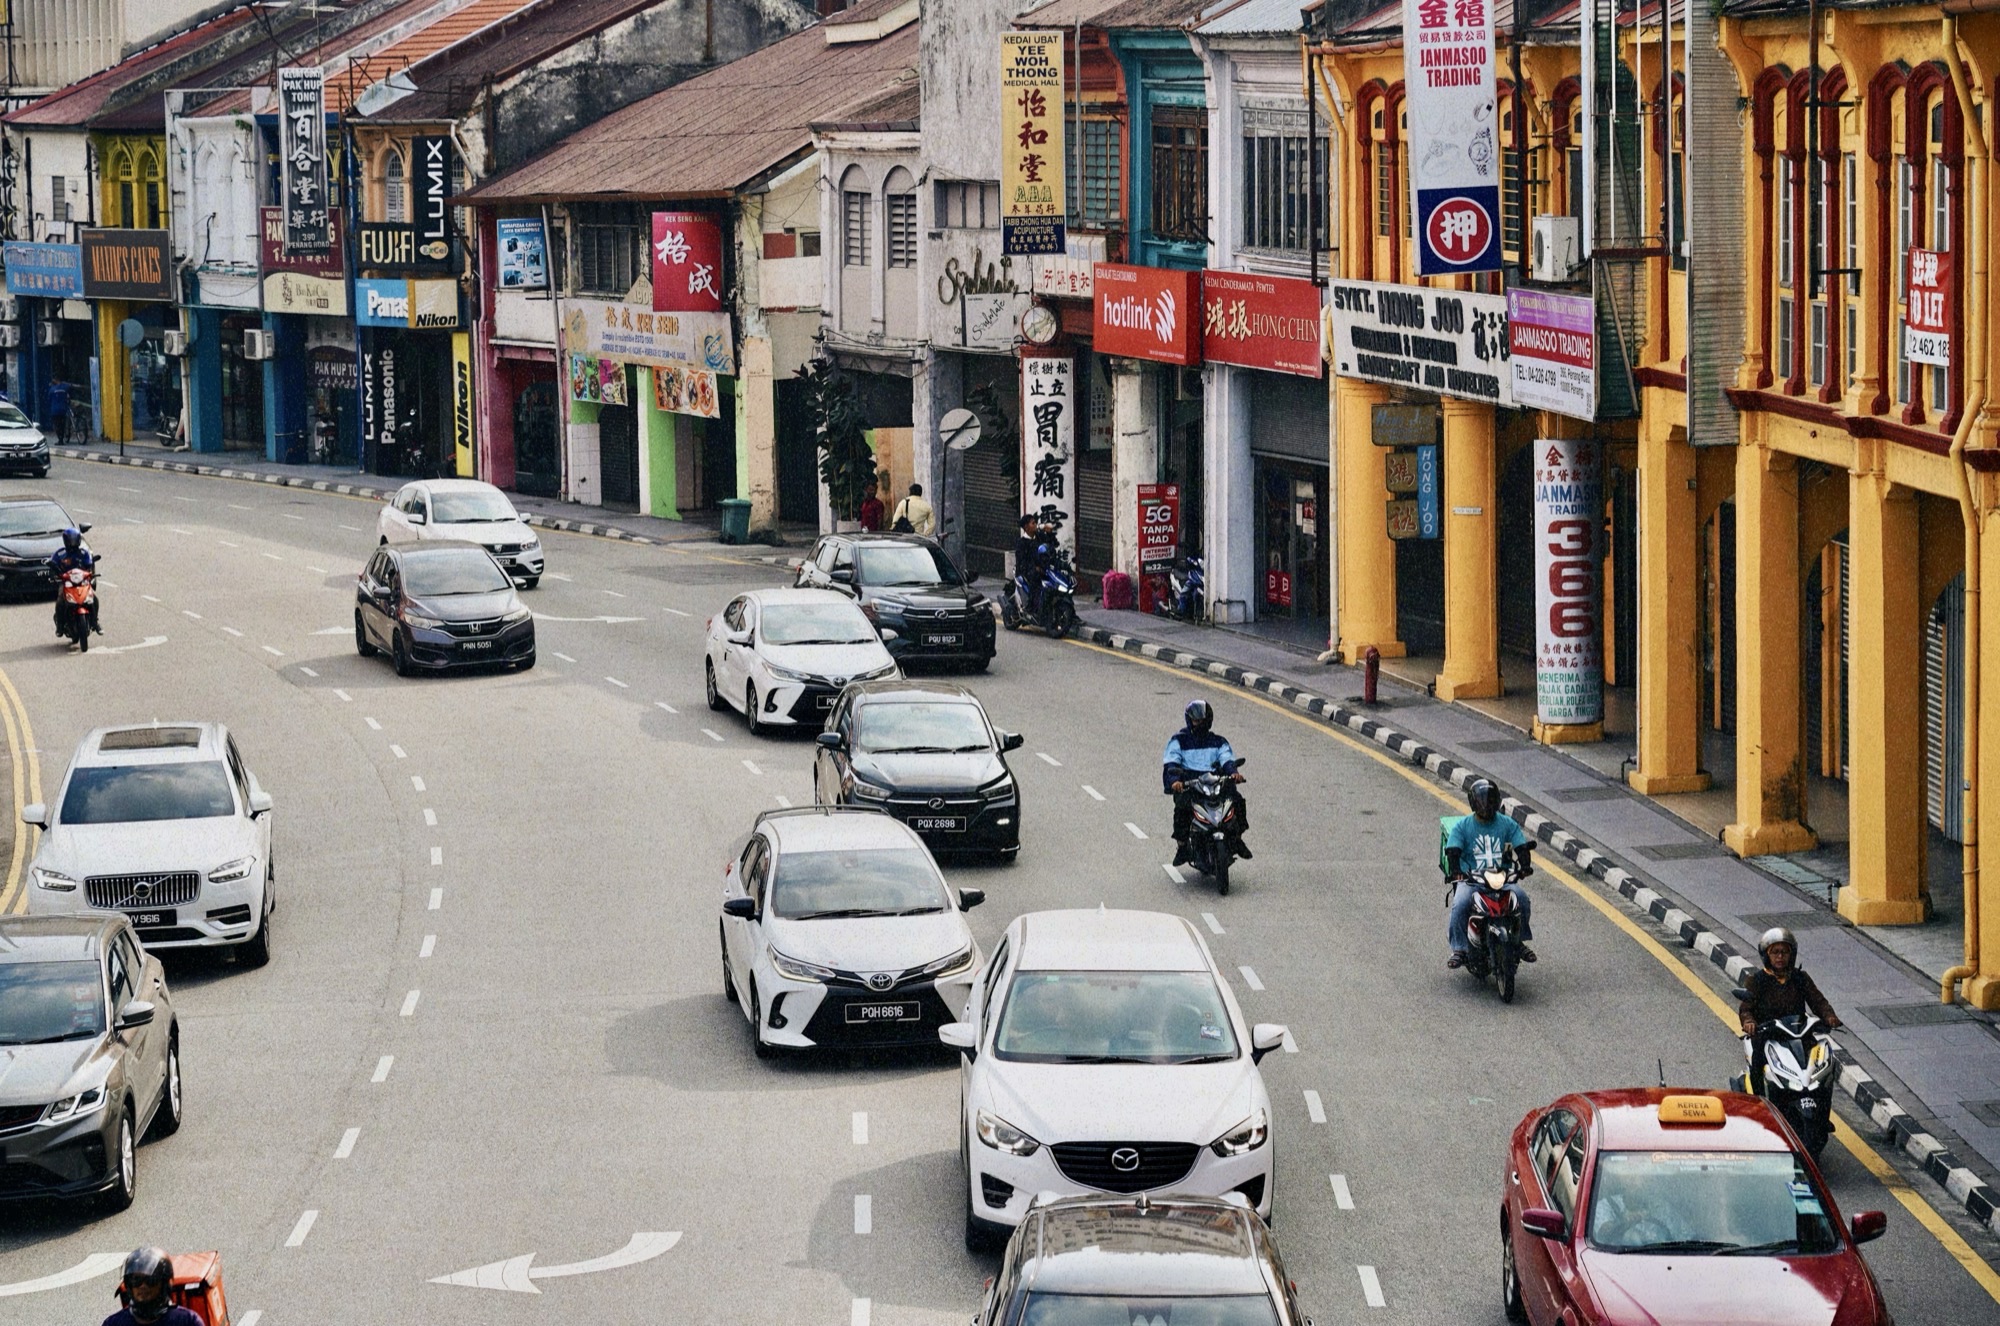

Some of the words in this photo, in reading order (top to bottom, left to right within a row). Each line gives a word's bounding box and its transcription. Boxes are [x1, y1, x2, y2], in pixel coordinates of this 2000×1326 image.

[1004, 36, 1031, 44] KEDAI
[1034, 36, 1058, 44] UBAT
[1018, 46, 1046, 54] YEE
[1420, 46, 1486, 67] JANMASOO
[1015, 56, 1048, 66] WOH
[1006, 68, 1058, 78] THONG
[1427, 67, 1481, 87] TRADING
[283, 80, 302, 90] PAK
[304, 80, 321, 90] HUP
[292, 92, 315, 102] TONG
[1018, 89, 1048, 183] 怡和堂
[288, 110, 321, 204] 百合堂
[424, 140, 444, 238] LUMIX
[1014, 226, 1054, 234] ACUPUNCTURE
[1020, 218, 1039, 226] ZHONG
[1440, 210, 1478, 252] 押
[266, 222, 284, 242] PAK
[288, 240, 312, 248] PENANG
[92, 246, 128, 282] MAXIM'S
[132, 246, 161, 283] CAKES
[1205, 276, 1219, 288] KEDAI
[1220, 278, 1254, 292] CENDERAMATA
[1256, 282, 1274, 294] PEWTER
[1104, 294, 1152, 330] hotlink
[1334, 286, 1374, 314] SYKT.
[1377, 290, 1424, 330] HONG
[1431, 296, 1464, 334] JOO
[1924, 292, 1944, 328] LET
[416, 314, 456, 326] Nikon
[637, 313, 654, 334] KEK
[656, 316, 678, 336] SENG
[1252, 317, 1286, 337] HONG
[1288, 317, 1318, 342] CHIN
[1514, 326, 1557, 352] JANMASOO
[1559, 333, 1590, 359] TRADING
[1919, 338, 1934, 356] 462
[314, 362, 329, 374] PAK
[330, 364, 346, 376] HUP
[1357, 354, 1420, 384] HANDICRAFT
[1424, 364, 1445, 388] AND
[1447, 368, 1500, 398] NOVELTIES
[364, 354, 374, 440] LUMIX
[380, 350, 396, 444] Panasonic
[457, 361, 469, 448] Nikon
[1422, 450, 1432, 493] HONG
[1146, 505, 1171, 523] 5G
[1422, 502, 1432, 534] JOO
[1549, 504, 1592, 514] TRADING
[1142, 525, 1174, 534] TANPA
[1148, 536, 1169, 544] HAD
[1538, 673, 1580, 682] MENERIMA
[1538, 684, 1561, 694] PAJAK
[1548, 708, 1573, 717] HARGA
[918, 819, 933, 828] PQX
[934, 819, 955, 828] 2698
[140, 914, 160, 923] 9616
[862, 1006, 880, 1018] PQH
[882, 1006, 903, 1017] 6616
